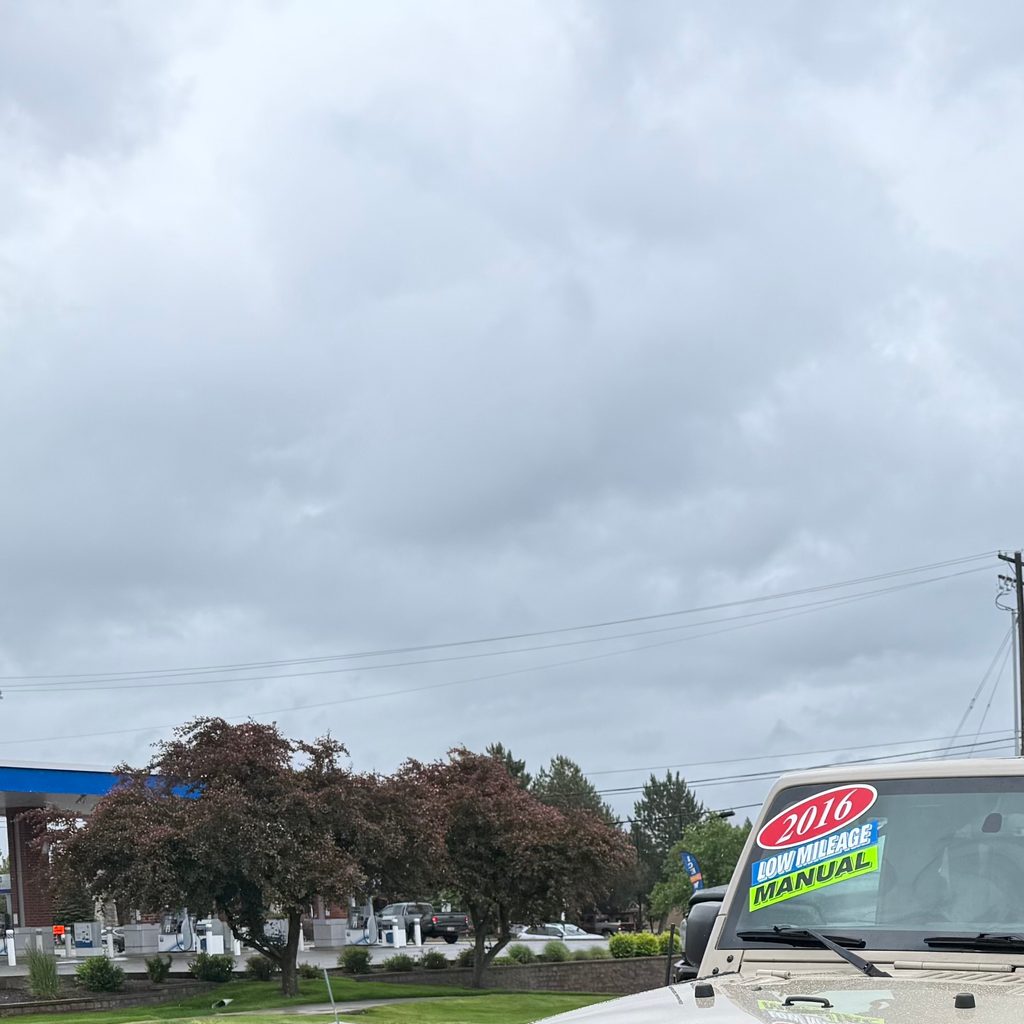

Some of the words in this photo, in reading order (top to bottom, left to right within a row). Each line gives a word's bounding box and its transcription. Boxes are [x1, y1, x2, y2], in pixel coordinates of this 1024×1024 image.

[775, 788, 858, 845] 2016
[753, 851, 873, 906] MANUAL
[757, 850, 796, 883] LOW
[795, 823, 873, 868] MILEAGE
